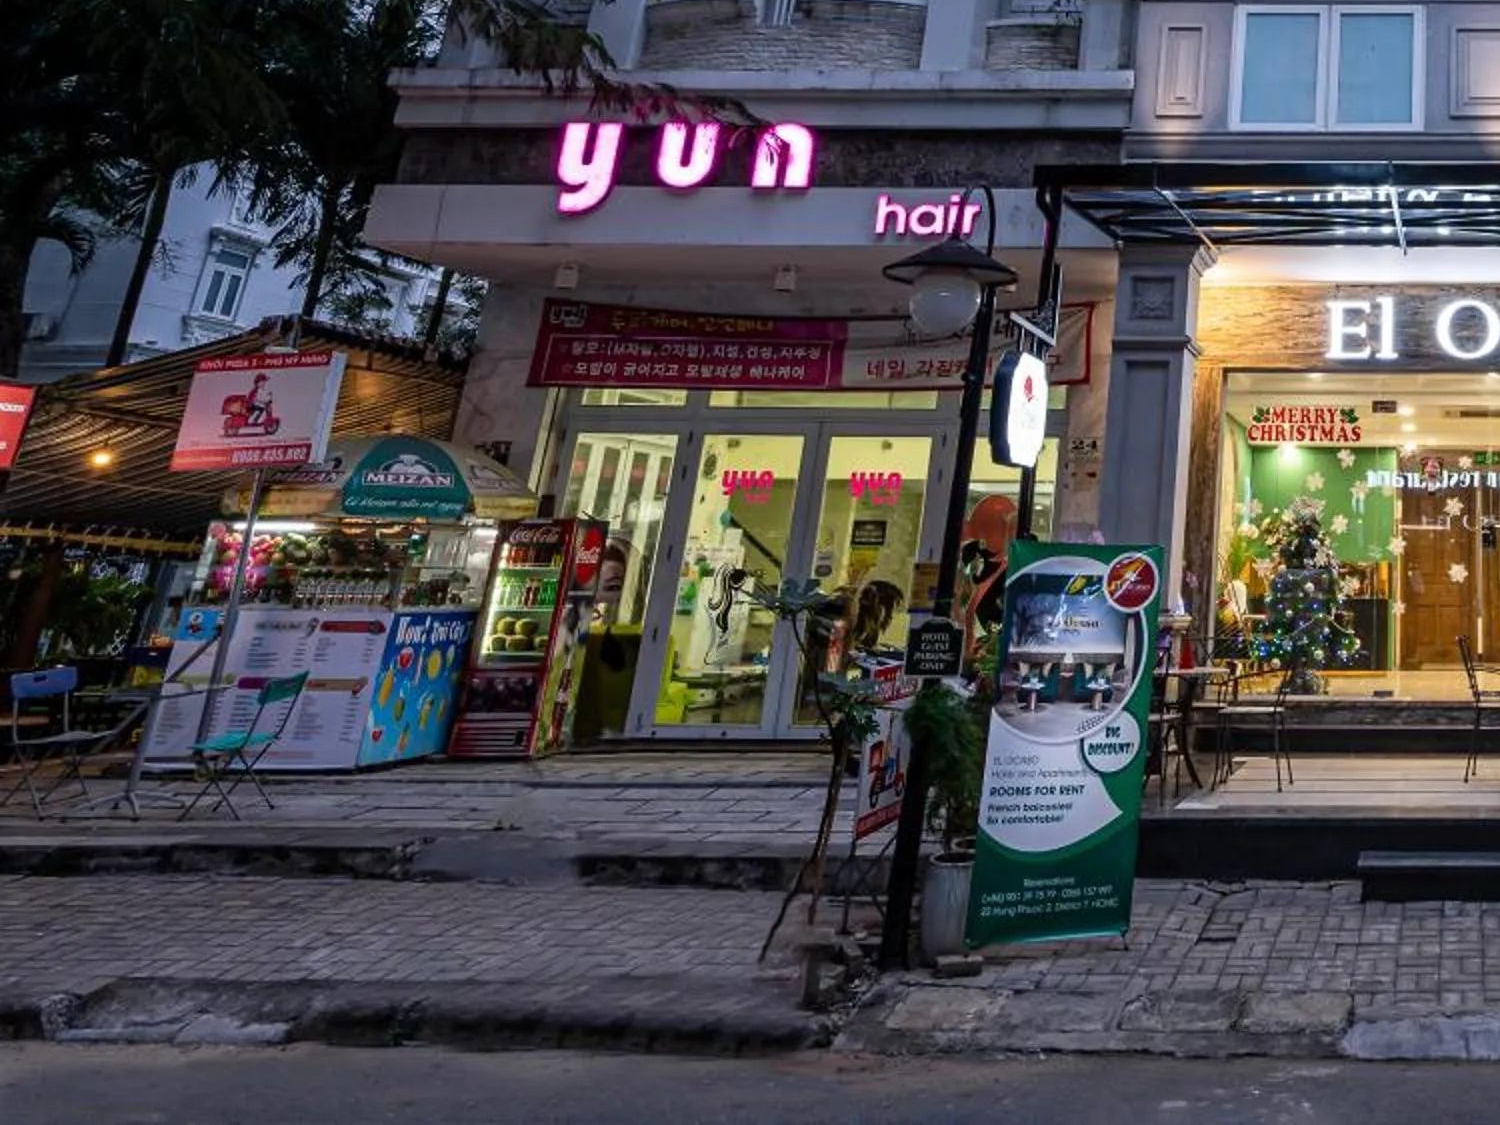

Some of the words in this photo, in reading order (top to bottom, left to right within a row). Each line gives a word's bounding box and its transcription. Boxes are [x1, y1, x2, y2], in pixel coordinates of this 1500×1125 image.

[556, 121, 816, 213] yun
[875, 194, 982, 236] hair
[1325, 295, 1397, 361] El
[1271, 406, 1338, 424] MERRY
[1247, 424, 1361, 442] CHRISTMAS
[364, 472, 452, 487] MEIZAN
[721, 470, 775, 496] yun
[850, 472, 903, 499] yun
[989, 786, 1033, 797] ROOMS
[1034, 785, 1057, 796] FOR
[1059, 783, 1085, 796] RENT
